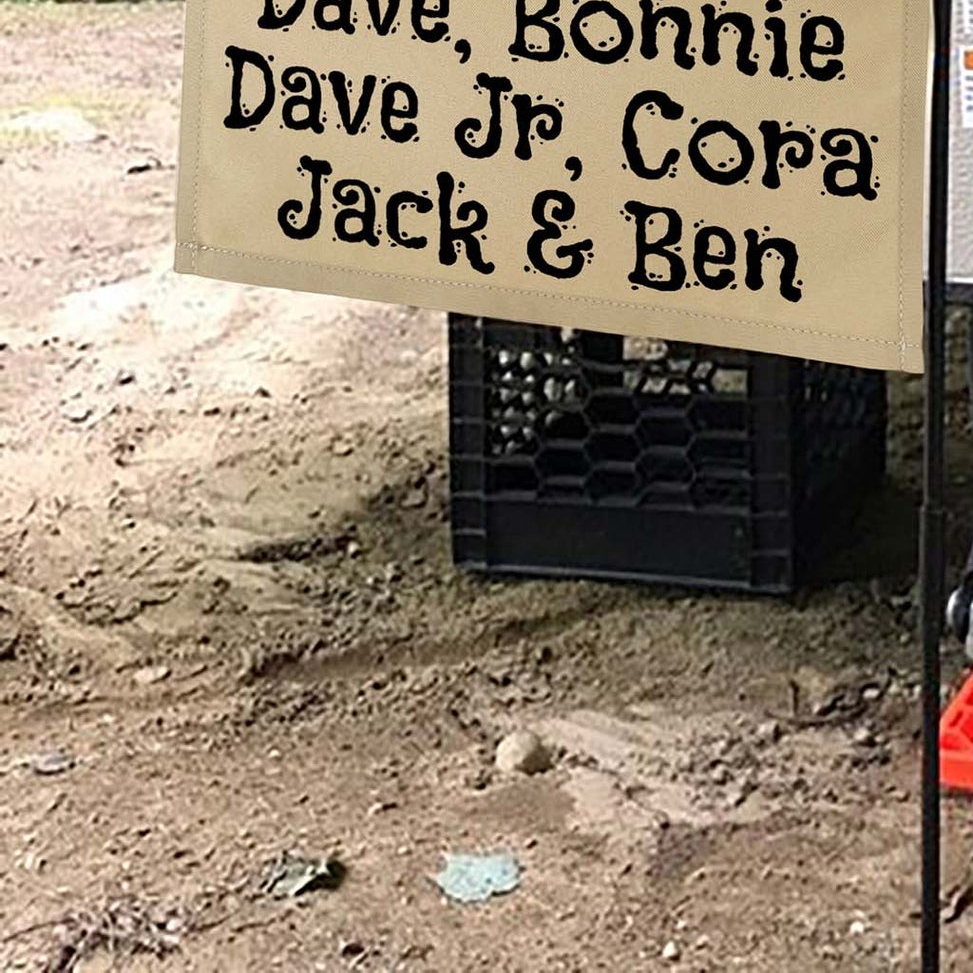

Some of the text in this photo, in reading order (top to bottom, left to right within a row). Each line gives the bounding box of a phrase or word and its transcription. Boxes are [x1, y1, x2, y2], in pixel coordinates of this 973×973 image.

[224, 46, 880, 200] Dave Jr, Cora
[278, 156, 802, 302] Jack & Ben
